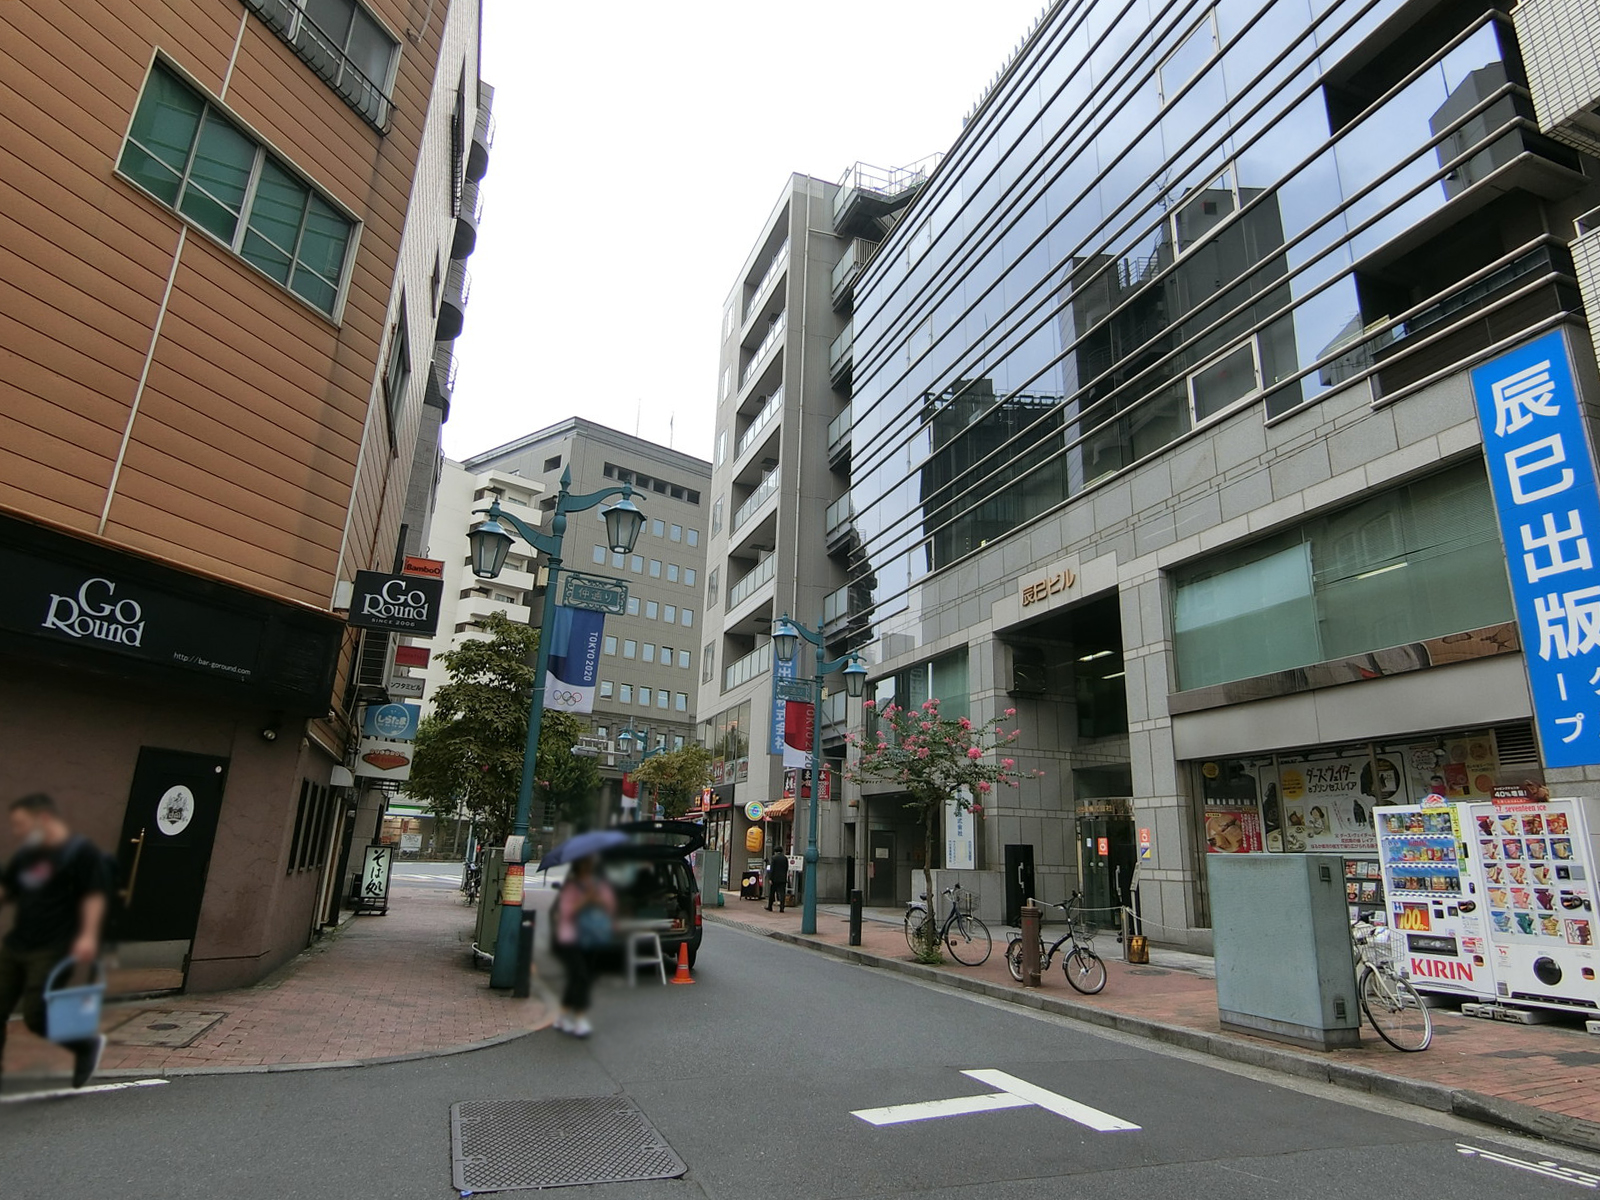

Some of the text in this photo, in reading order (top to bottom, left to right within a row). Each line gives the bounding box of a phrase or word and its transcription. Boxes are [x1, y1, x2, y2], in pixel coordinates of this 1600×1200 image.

[1491, 359, 1600, 663] 辰巳出版
[78, 577, 142, 625] Go
[361, 593, 429, 620] Round
[382, 580, 426, 607] Go
[578, 586, 613, 603] 仲通り
[1022, 568, 1076, 607] 辰巳ビル
[41, 593, 146, 648] Round
[583, 631, 599, 682] TOKYO 2020
[365, 848, 386, 897] そば処
[1410, 957, 1474, 982] KIRIN
